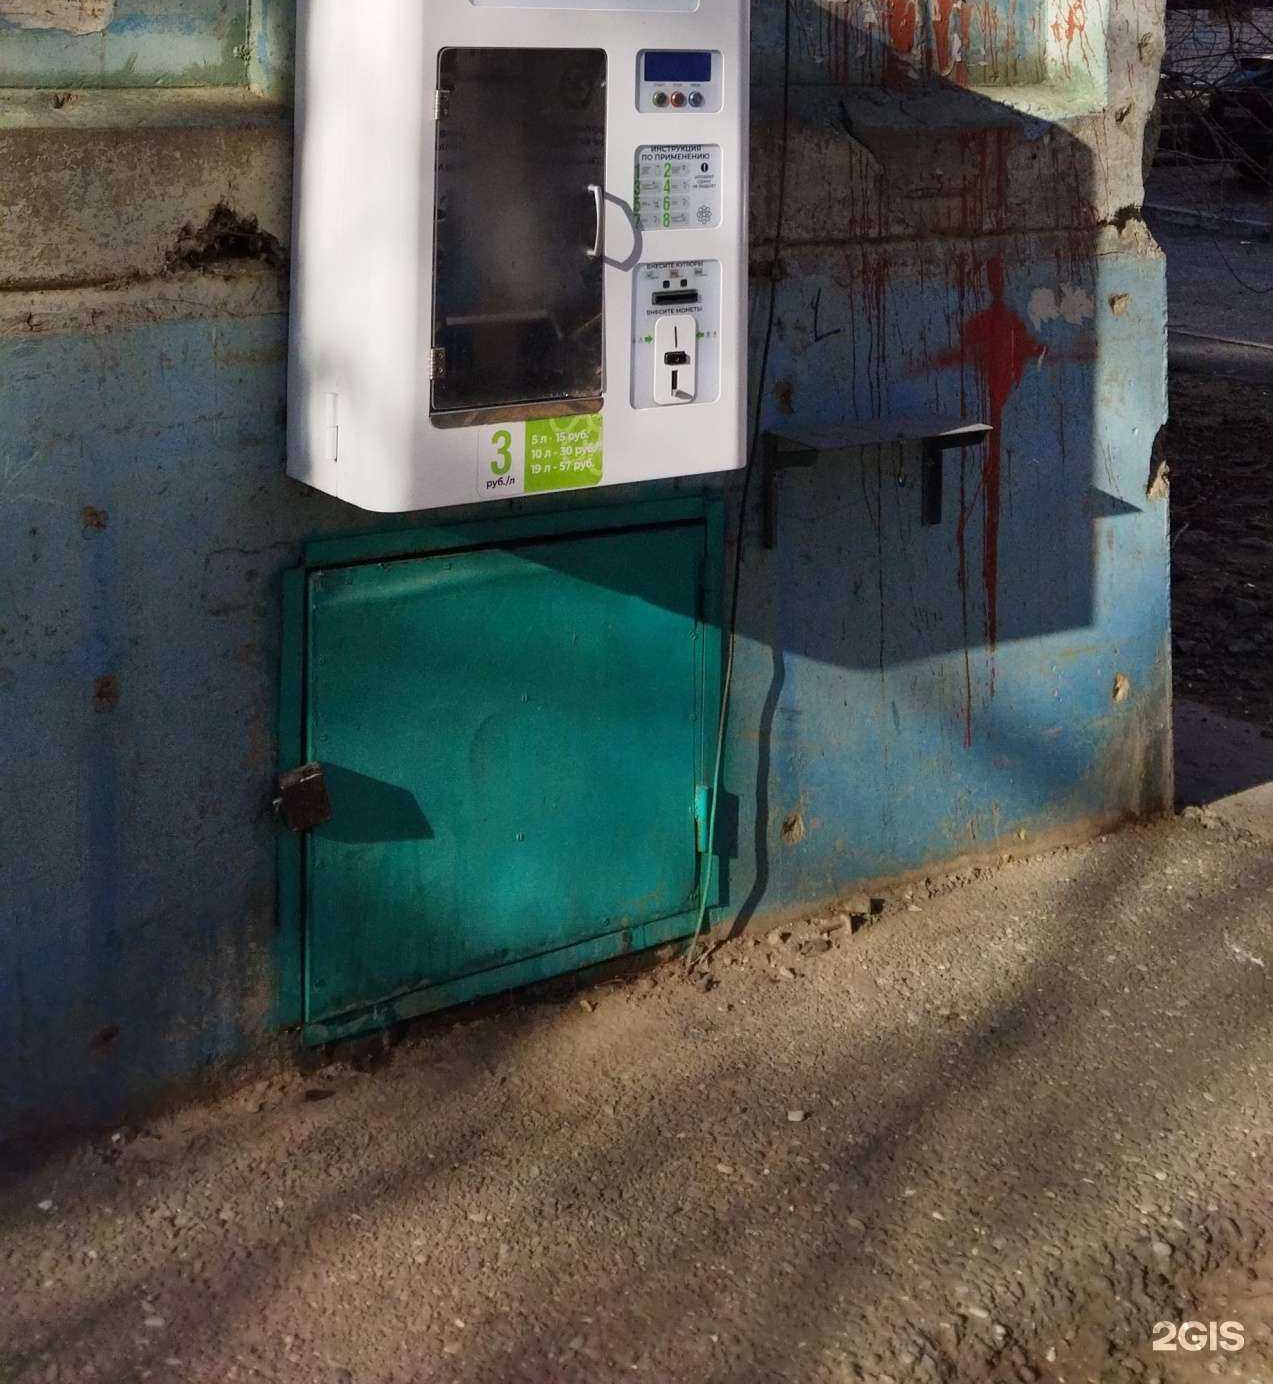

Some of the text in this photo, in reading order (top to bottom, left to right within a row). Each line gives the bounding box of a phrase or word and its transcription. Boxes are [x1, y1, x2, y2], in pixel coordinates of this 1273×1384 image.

[655, 153, 710, 161] ПРИМЕНЕНИЮ
[664, 162, 671, 177] 2
[664, 179, 670, 193] 4
[663, 196, 670, 211] 6
[663, 213, 670, 227] 8
[531, 434, 539, 445] 5
[490, 429, 512, 475] 3
[531, 449, 542, 459] 10
[544, 449, 552, 458] л
[530, 463, 541, 474] 19
[544, 464, 551, 473] л
[560, 461, 571, 471] 57
[486, 476, 515, 489] руб./л
